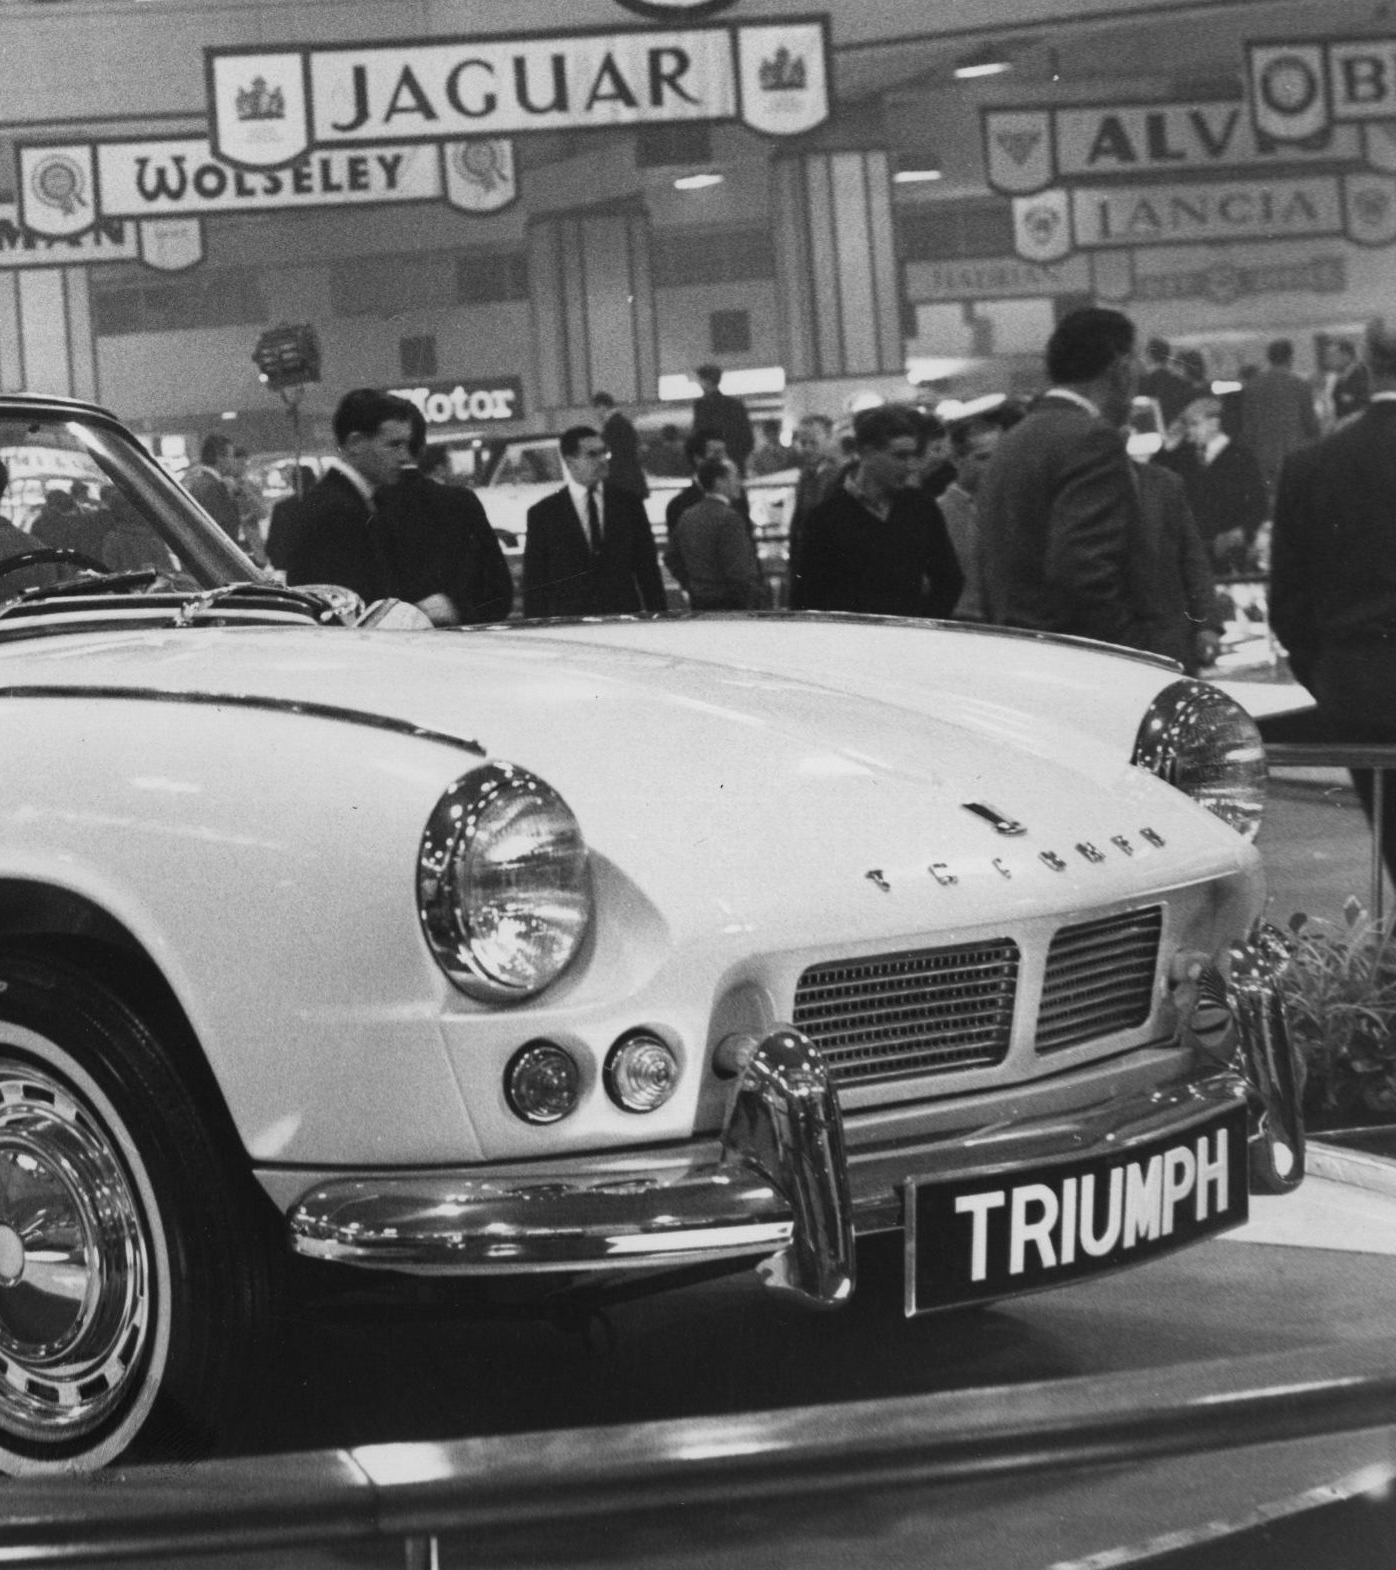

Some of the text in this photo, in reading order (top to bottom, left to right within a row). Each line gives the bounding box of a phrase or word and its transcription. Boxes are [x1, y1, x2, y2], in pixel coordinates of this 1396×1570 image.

[330, 46, 702, 132] JAGUAR
[1086, 108, 1332, 166] ALV
[134, 153, 403, 201] WOLSELEY
[955, 1128, 1228, 1281] TRIUMPH
